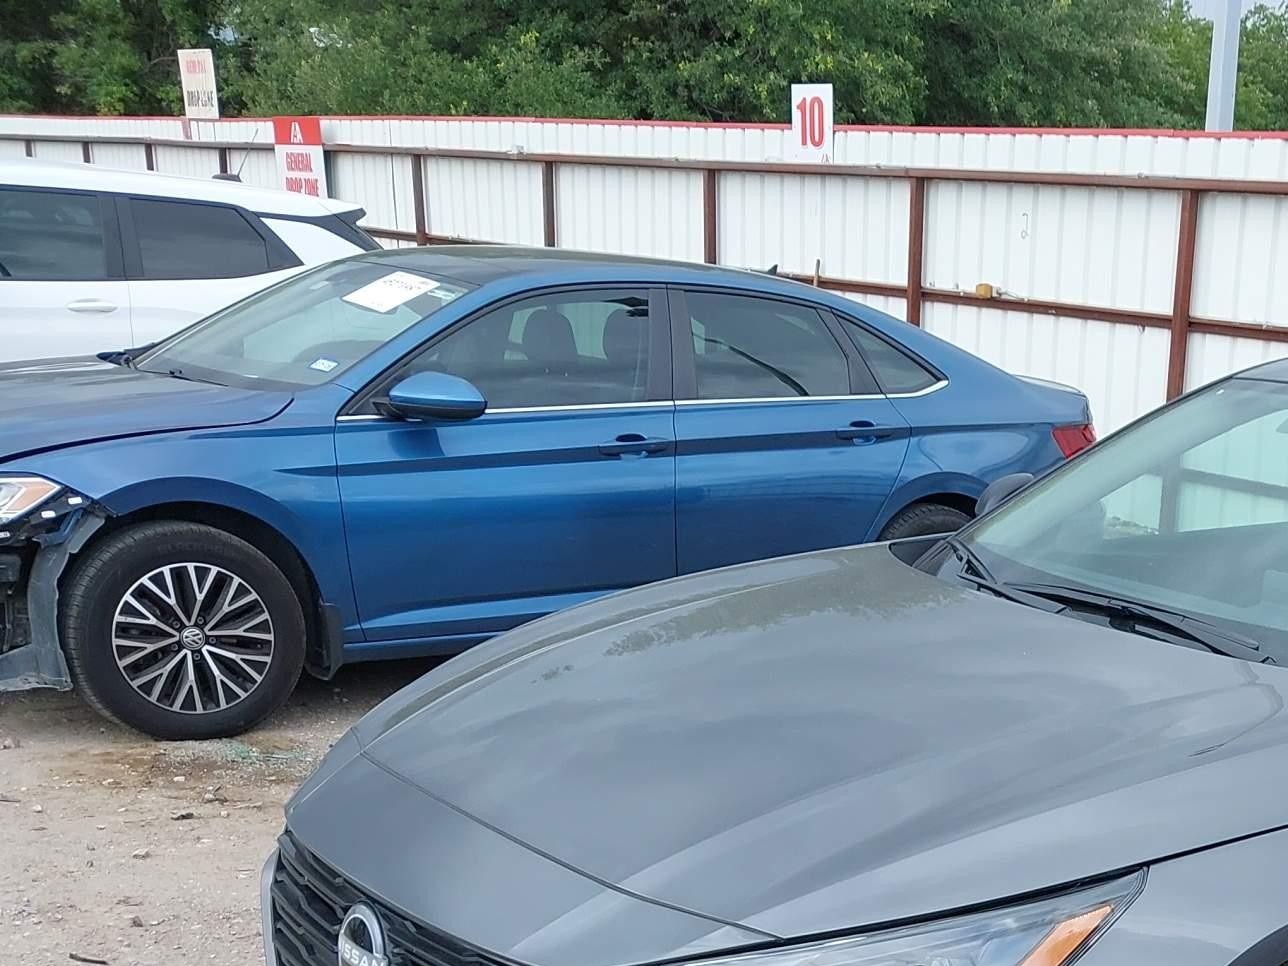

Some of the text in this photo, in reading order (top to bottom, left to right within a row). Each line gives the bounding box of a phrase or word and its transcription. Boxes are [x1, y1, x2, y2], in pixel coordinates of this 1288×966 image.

[796, 96, 824, 147] 10
[286, 151, 313, 173] GENERAL
[285, 176, 320, 197] DROP ZONE
